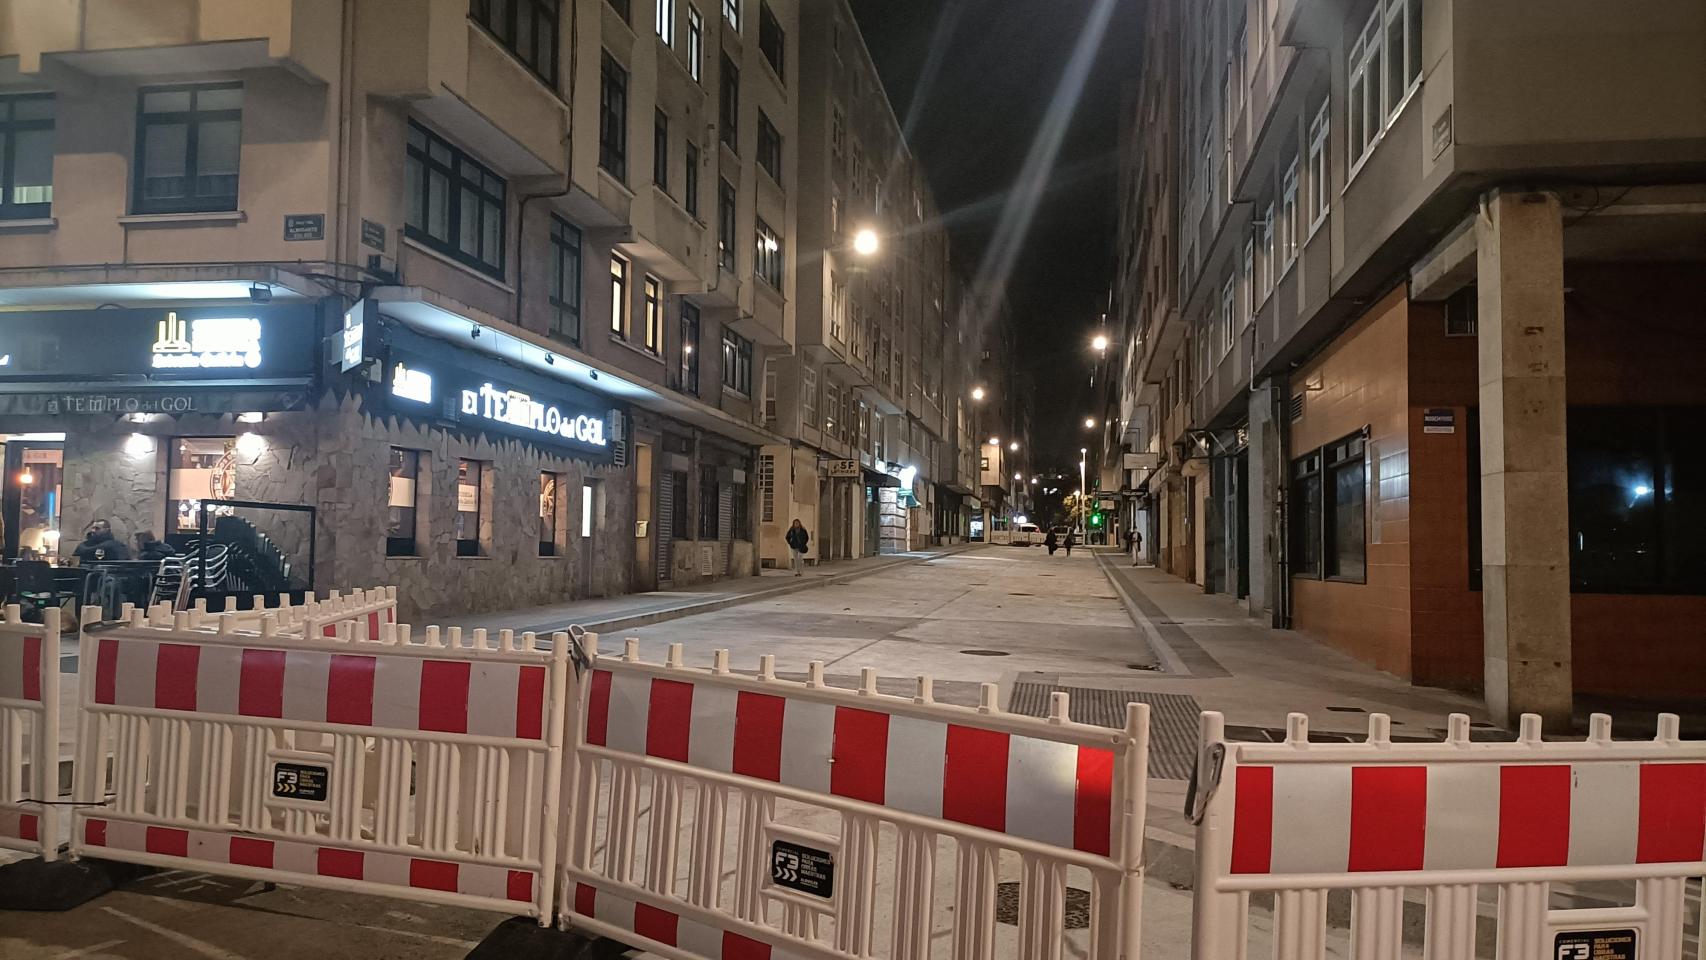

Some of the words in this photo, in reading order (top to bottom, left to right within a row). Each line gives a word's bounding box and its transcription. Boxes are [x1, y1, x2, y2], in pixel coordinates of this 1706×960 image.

[160, 397, 198, 411] GOL
[576, 415, 607, 446] GOL
[277, 771, 298, 784] F3
[776, 851, 798, 870] F3
[1558, 944, 1590, 960] F3
